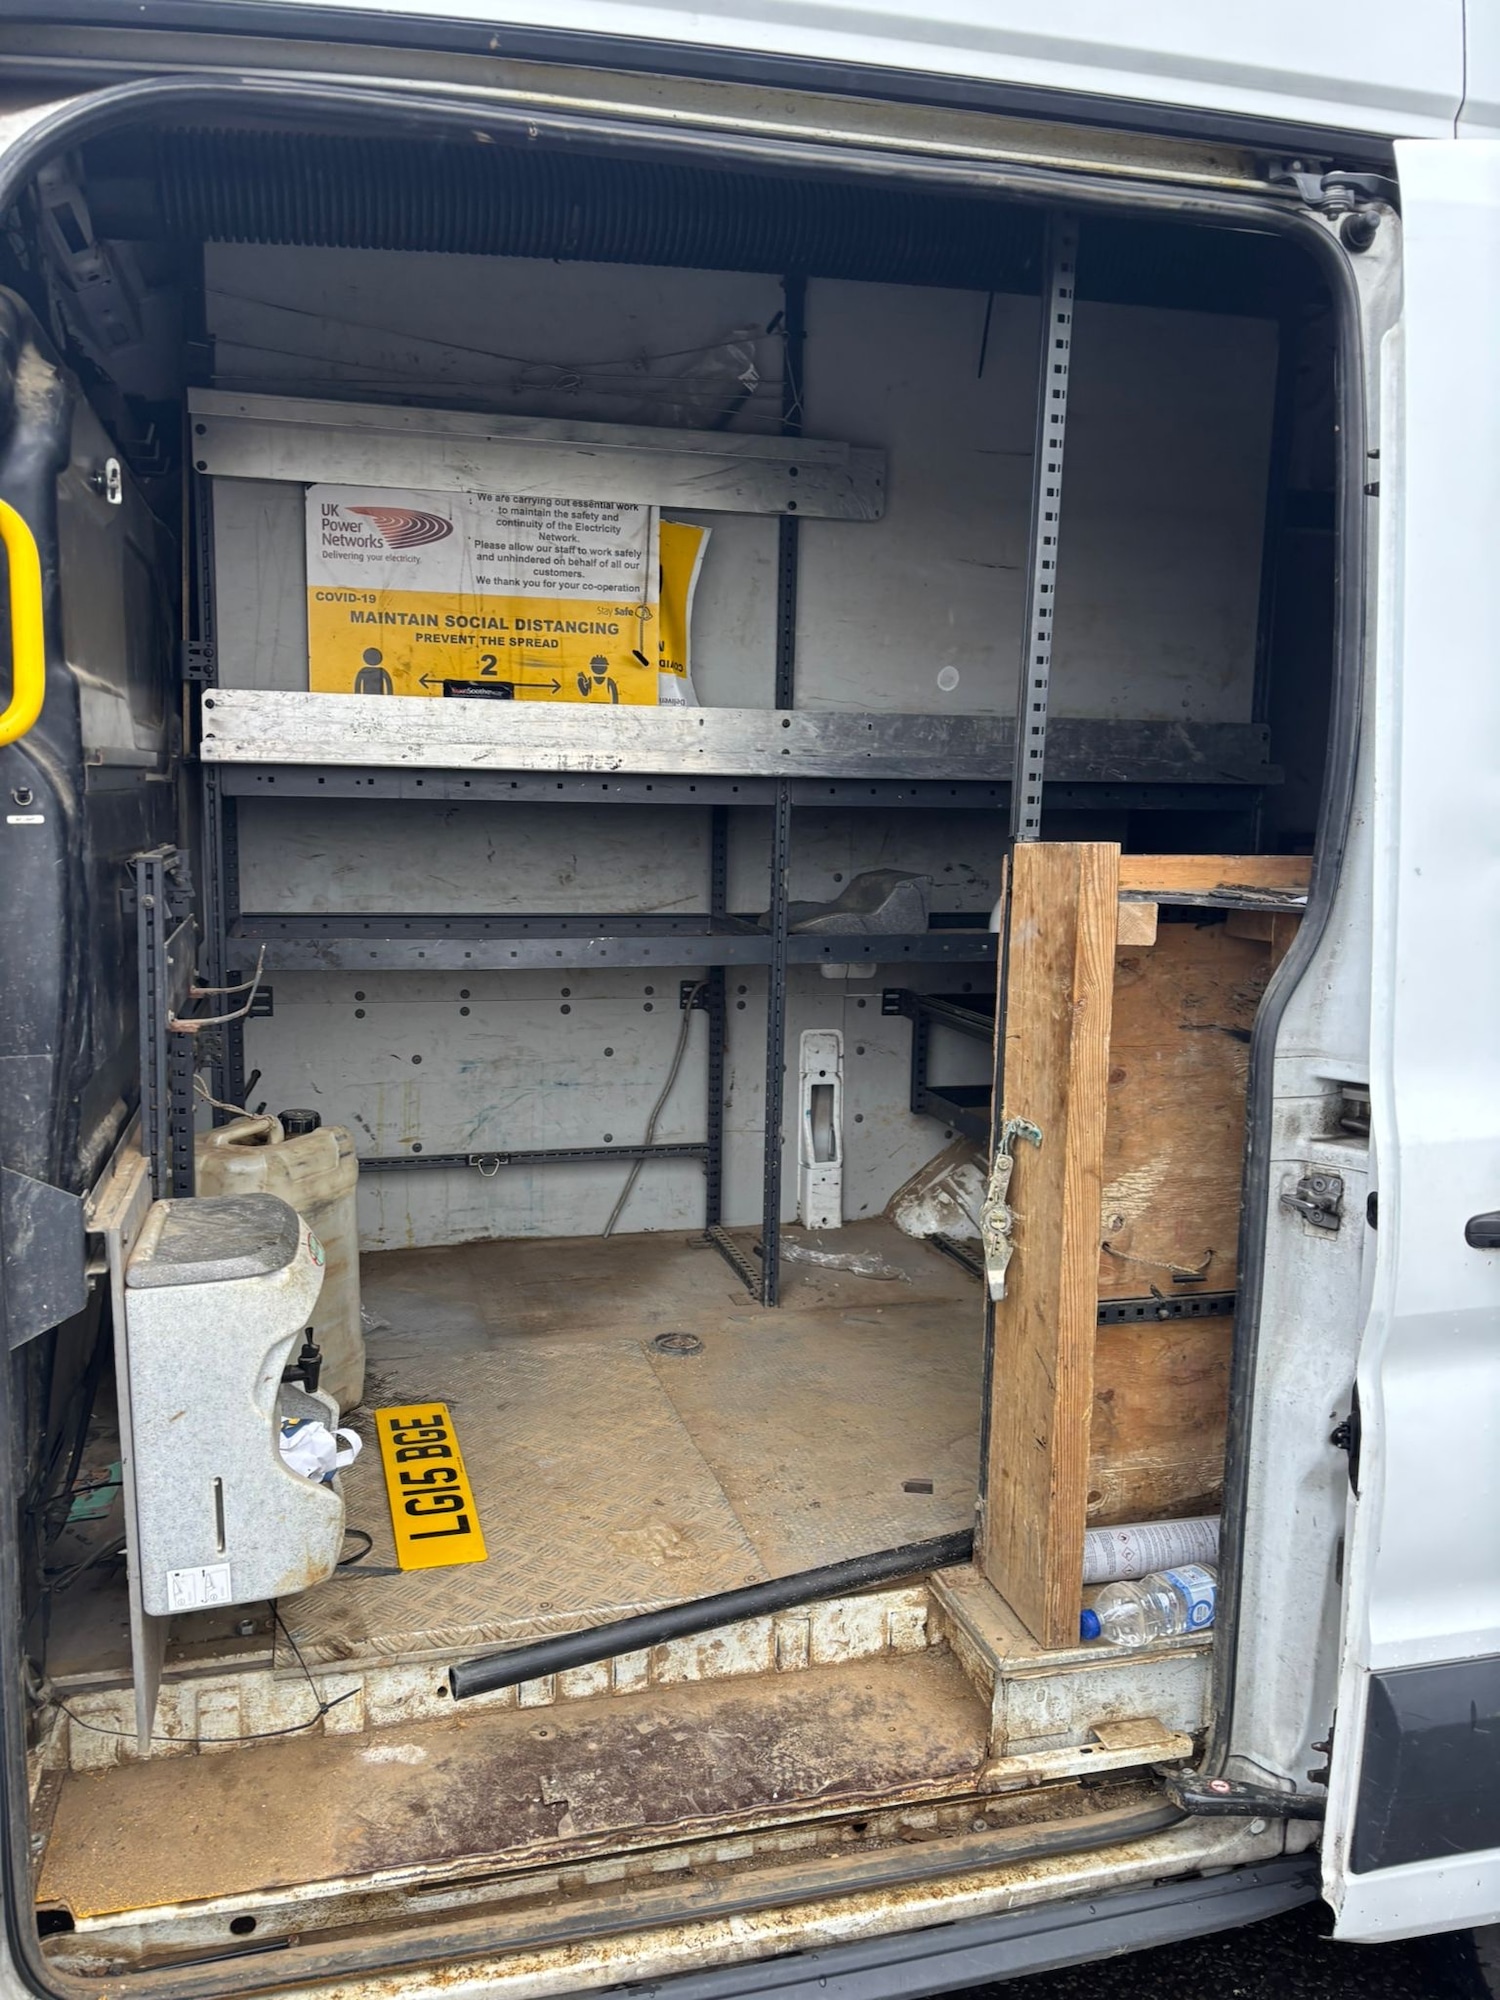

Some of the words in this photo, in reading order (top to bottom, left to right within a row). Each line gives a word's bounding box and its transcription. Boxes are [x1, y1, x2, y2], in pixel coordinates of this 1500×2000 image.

[321, 503, 340, 517] UK
[477, 493, 493, 502] We
[495, 494, 510, 503] are
[513, 496, 552, 507] carrying
[555, 498, 570, 507] out
[572, 499, 614, 510] essential
[616, 502, 639, 512] work
[498, 506, 509, 515] to
[511, 507, 551, 517] maintain
[554, 509, 569, 519] the
[571, 511, 599, 523] safety
[601, 513, 619, 522] and
[321, 518, 363, 534] Power
[496, 519, 544, 531] continuity
[546, 520, 556, 530] of
[557, 521, 573, 531] the
[575, 522, 622, 536] Electricity
[321, 533, 384, 550] Networks
[538, 532, 580, 543] Network.
[321, 550, 364, 563] Delivering
[366, 554, 384, 563] your
[384, 553, 421, 565] electricity
[474, 540, 507, 551] Please
[508, 541, 535, 552] allow
[536, 545, 553, 553] our
[554, 545, 576, 555] staff
[577, 546, 588, 556] to
[589, 547, 613, 557] work
[614, 549, 642, 560] safely
[476, 552, 495, 562] and
[497, 553, 551, 565] unhindered
[553, 557, 566, 566] on
[568, 557, 598, 568] behalf
[599, 558, 609, 569] of
[610, 560, 622, 569] all
[624, 561, 641, 570] our
[533, 568, 586, 578] customers.
[475, 575, 491, 585] We
[493, 576, 521, 587] thank
[522, 580, 541, 589] you
[542, 579, 557, 588] for
[558, 581, 581, 591] your
[582, 582, 641, 594] co-operation
[315, 591, 377, 604] COVID-19
[596, 606, 613, 618] Stay
[614, 606, 634, 617] Safe
[350, 610, 439, 627] MAINTAIN
[445, 614, 509, 631] SOCIAL
[514, 617, 620, 635] DISTANCING
[415, 632, 476, 645] PREVENT
[479, 635, 505, 646] THE
[508, 637, 559, 649] SPREAD
[480, 654, 498, 676] 2
[389, 1414, 453, 1464] BGE
[399, 1466, 471, 1541] LG15
